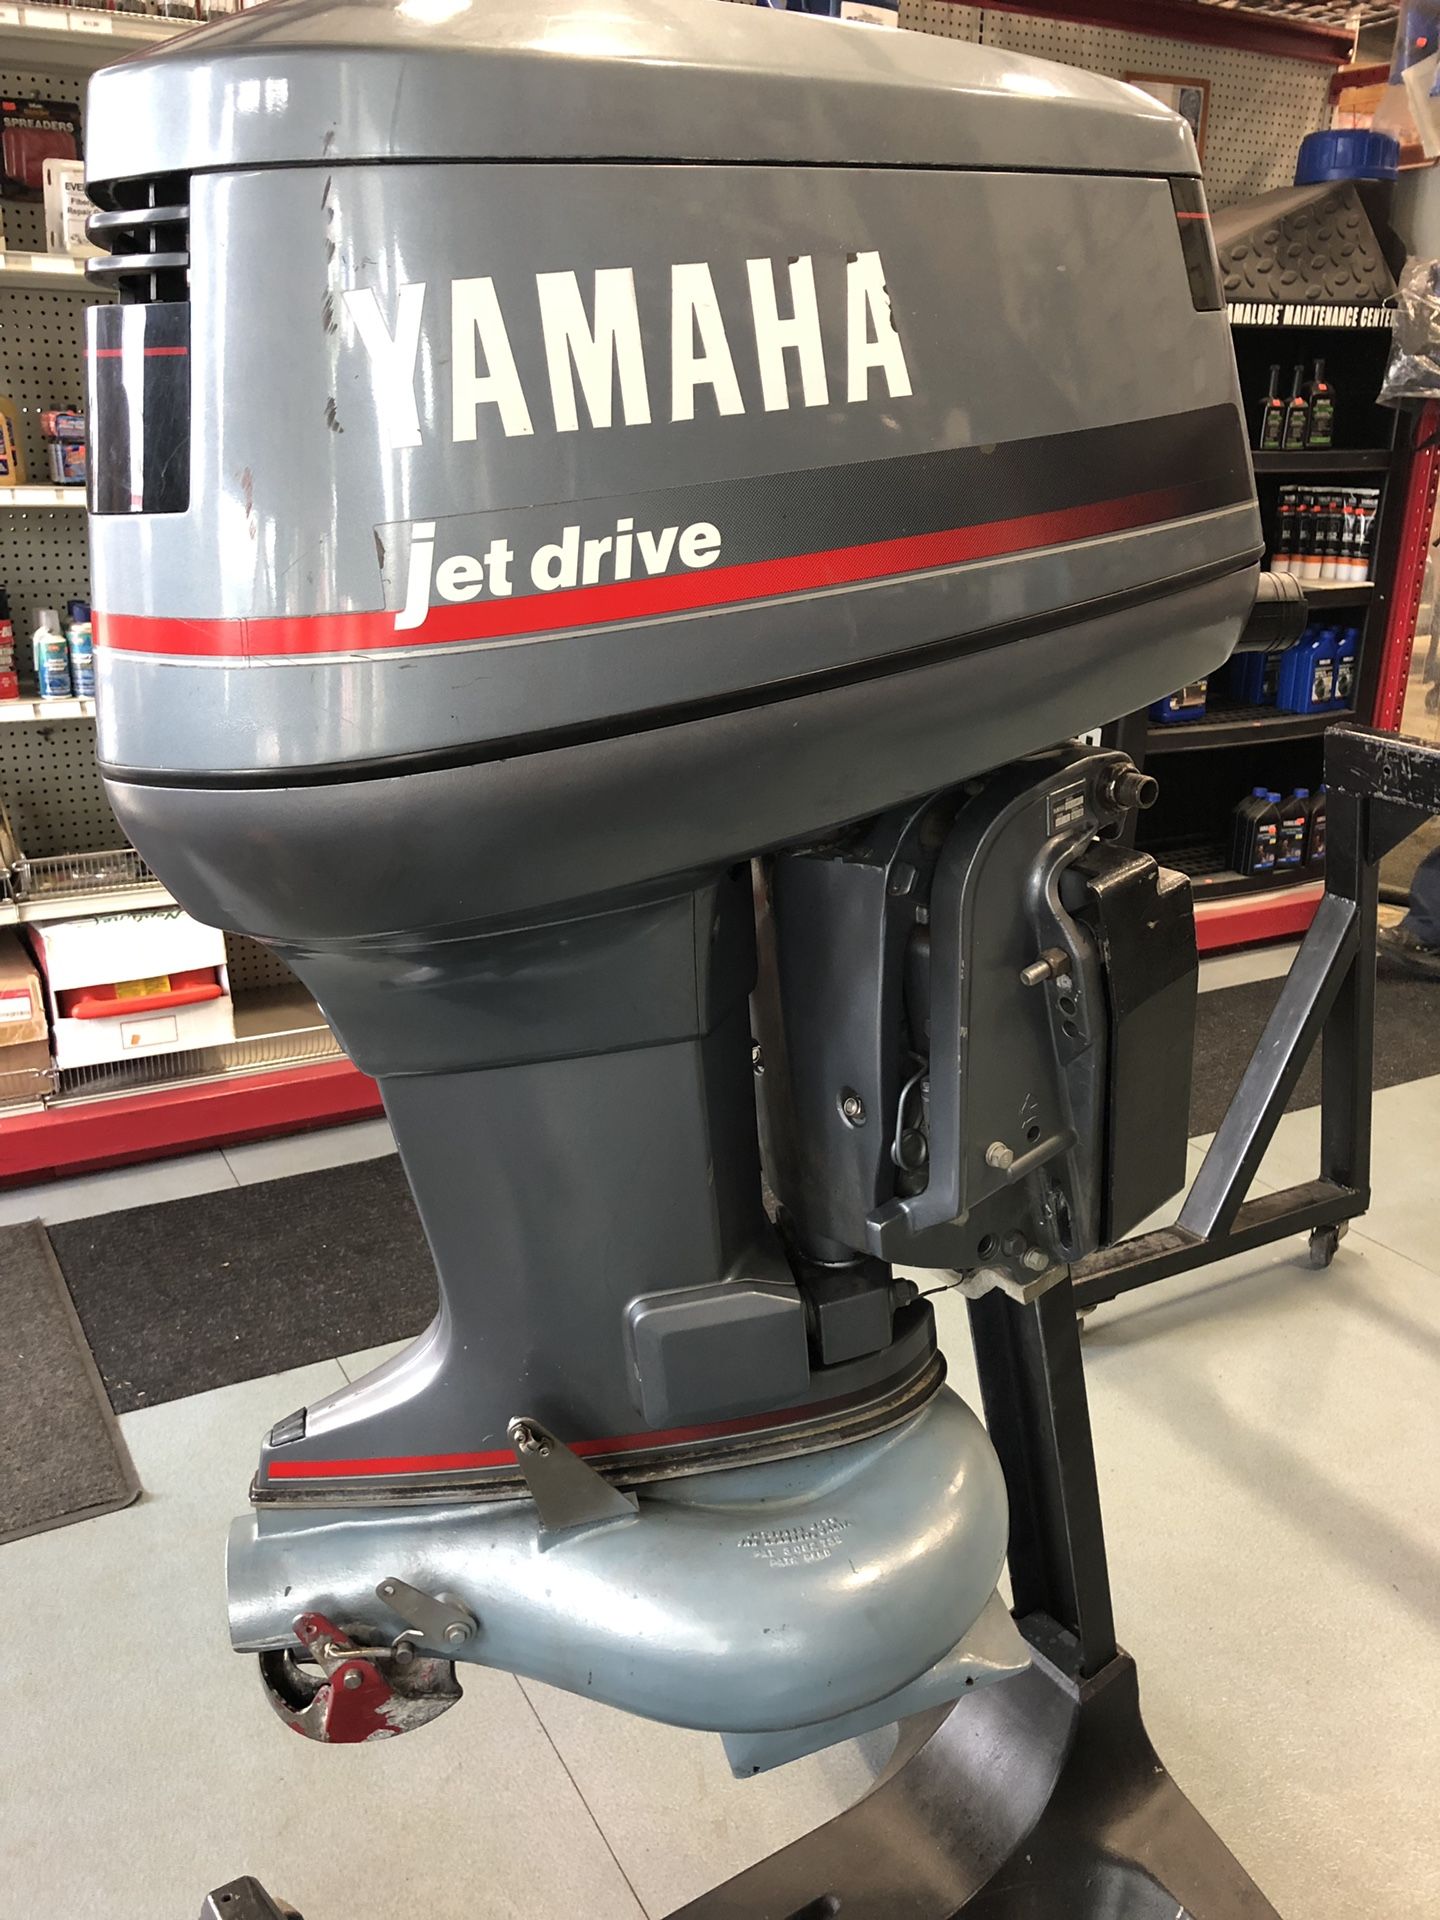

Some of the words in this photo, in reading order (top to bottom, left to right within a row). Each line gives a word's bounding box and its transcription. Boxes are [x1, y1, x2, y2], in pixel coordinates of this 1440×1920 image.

[3, 117, 75, 132] SPREADERS
[65, 182, 85, 191] EVE
[1227, 303, 1282, 325] AMALUBE
[1283, 304, 1359, 327] MAINTENANCE
[342, 251, 913, 449] YAMAHA
[394, 521, 514, 631] jet
[530, 517, 722, 592] drive
